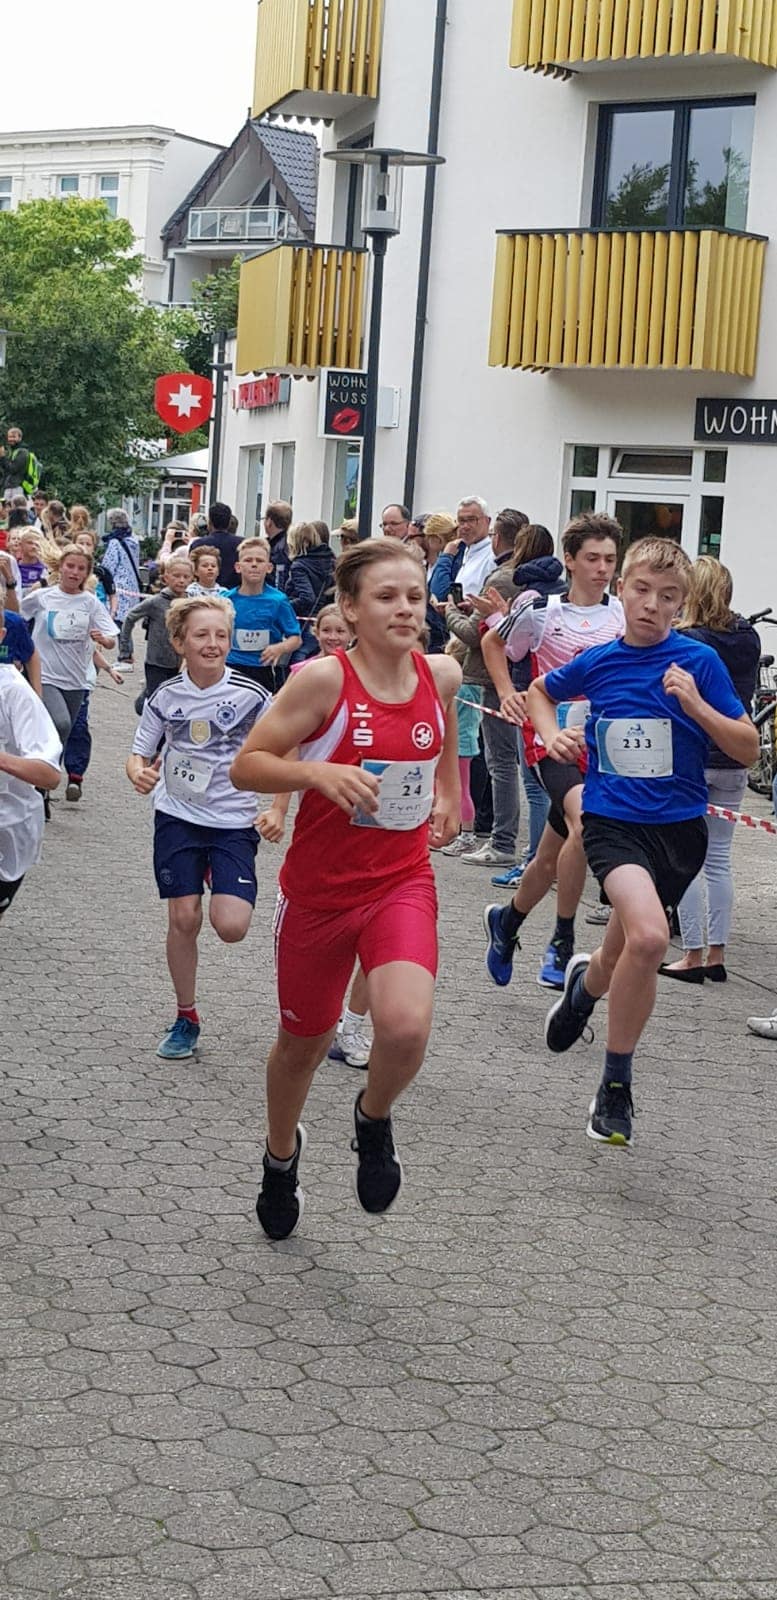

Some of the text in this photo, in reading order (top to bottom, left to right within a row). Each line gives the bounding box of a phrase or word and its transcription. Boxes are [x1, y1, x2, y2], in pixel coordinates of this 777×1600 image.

[329, 390, 368, 405] KUSS
[622, 738, 652, 749] 233
[172, 766, 196, 782] 590
[401, 784, 422, 797] 24
